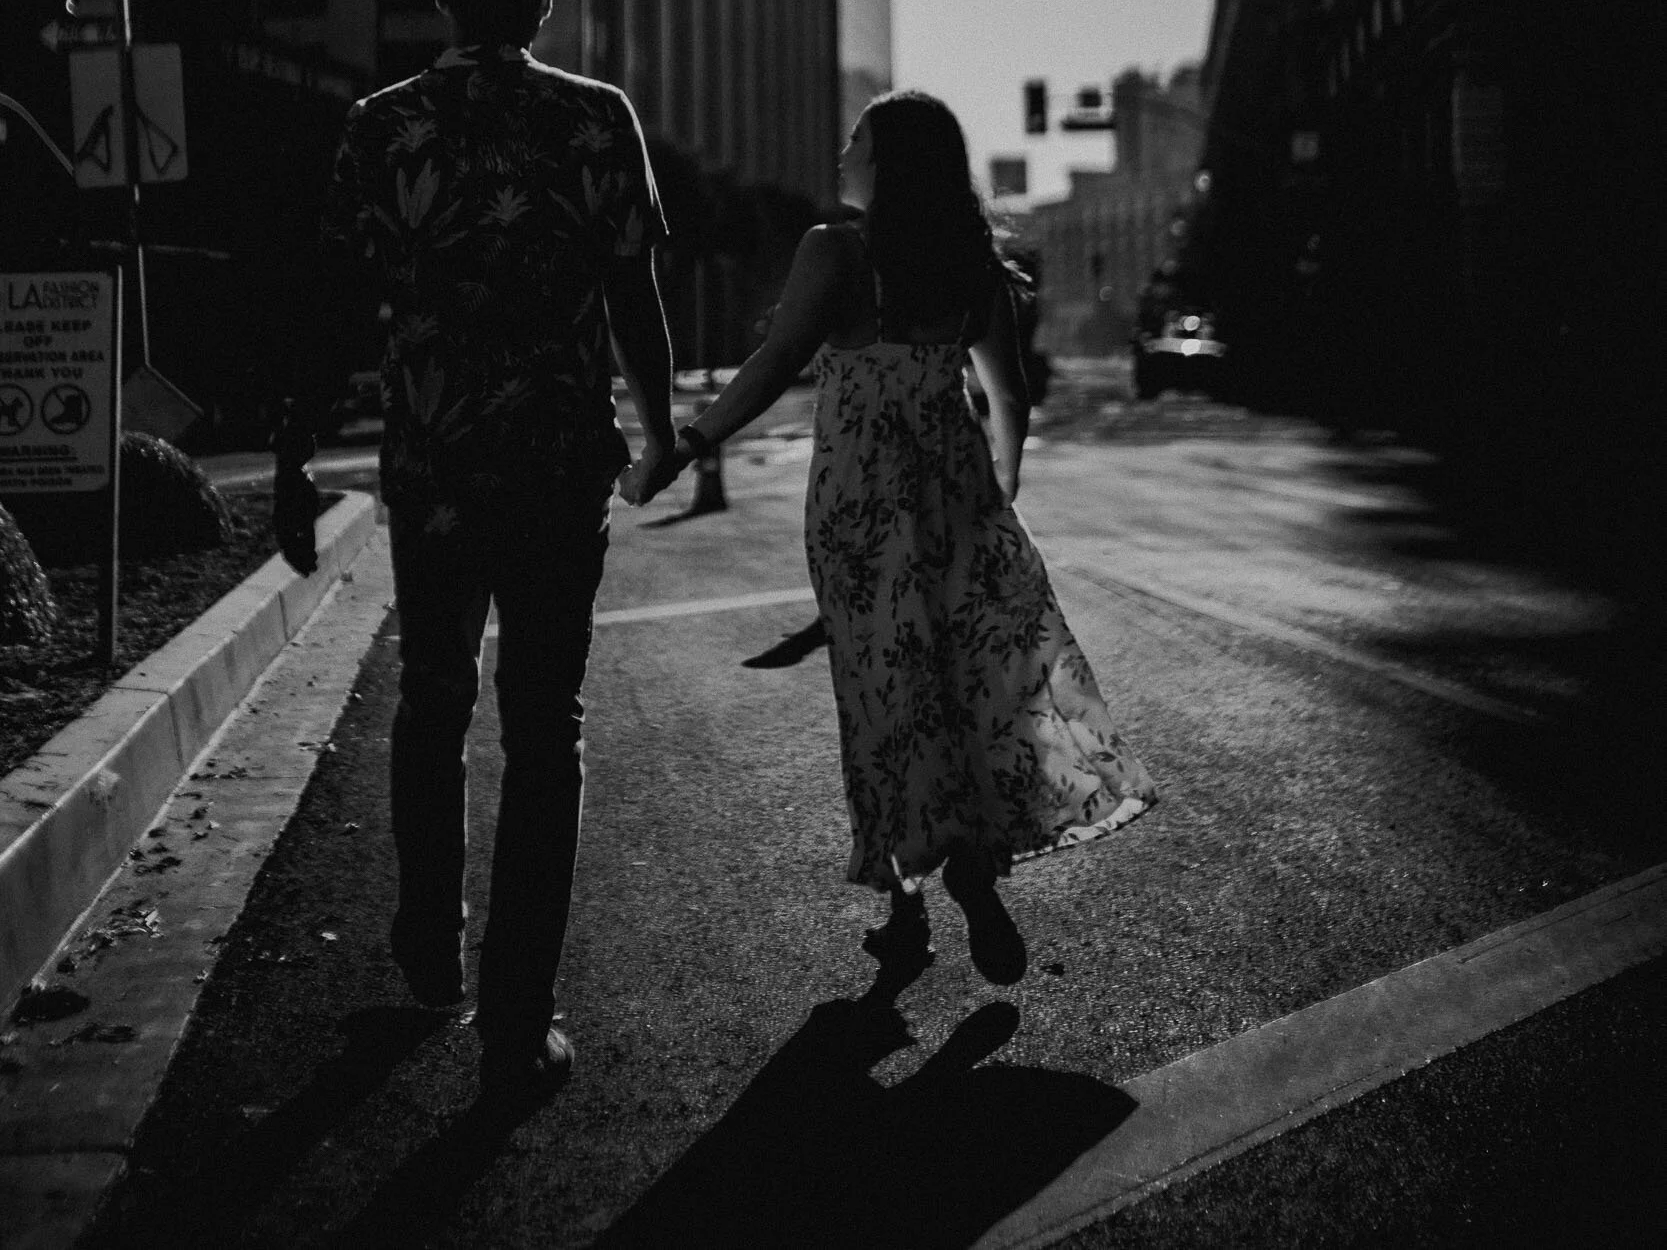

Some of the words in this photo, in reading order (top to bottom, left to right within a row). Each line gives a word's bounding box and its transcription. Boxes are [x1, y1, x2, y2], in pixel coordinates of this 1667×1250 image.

[8, 280, 41, 310] LA
[0, 319, 44, 334] EASE
[50, 318, 92, 333] KEEP
[23, 335, 53, 349] OFF
[71, 349, 104, 363] AREA
[0, 366, 45, 379] HANK
[50, 365, 83, 380] YOU
